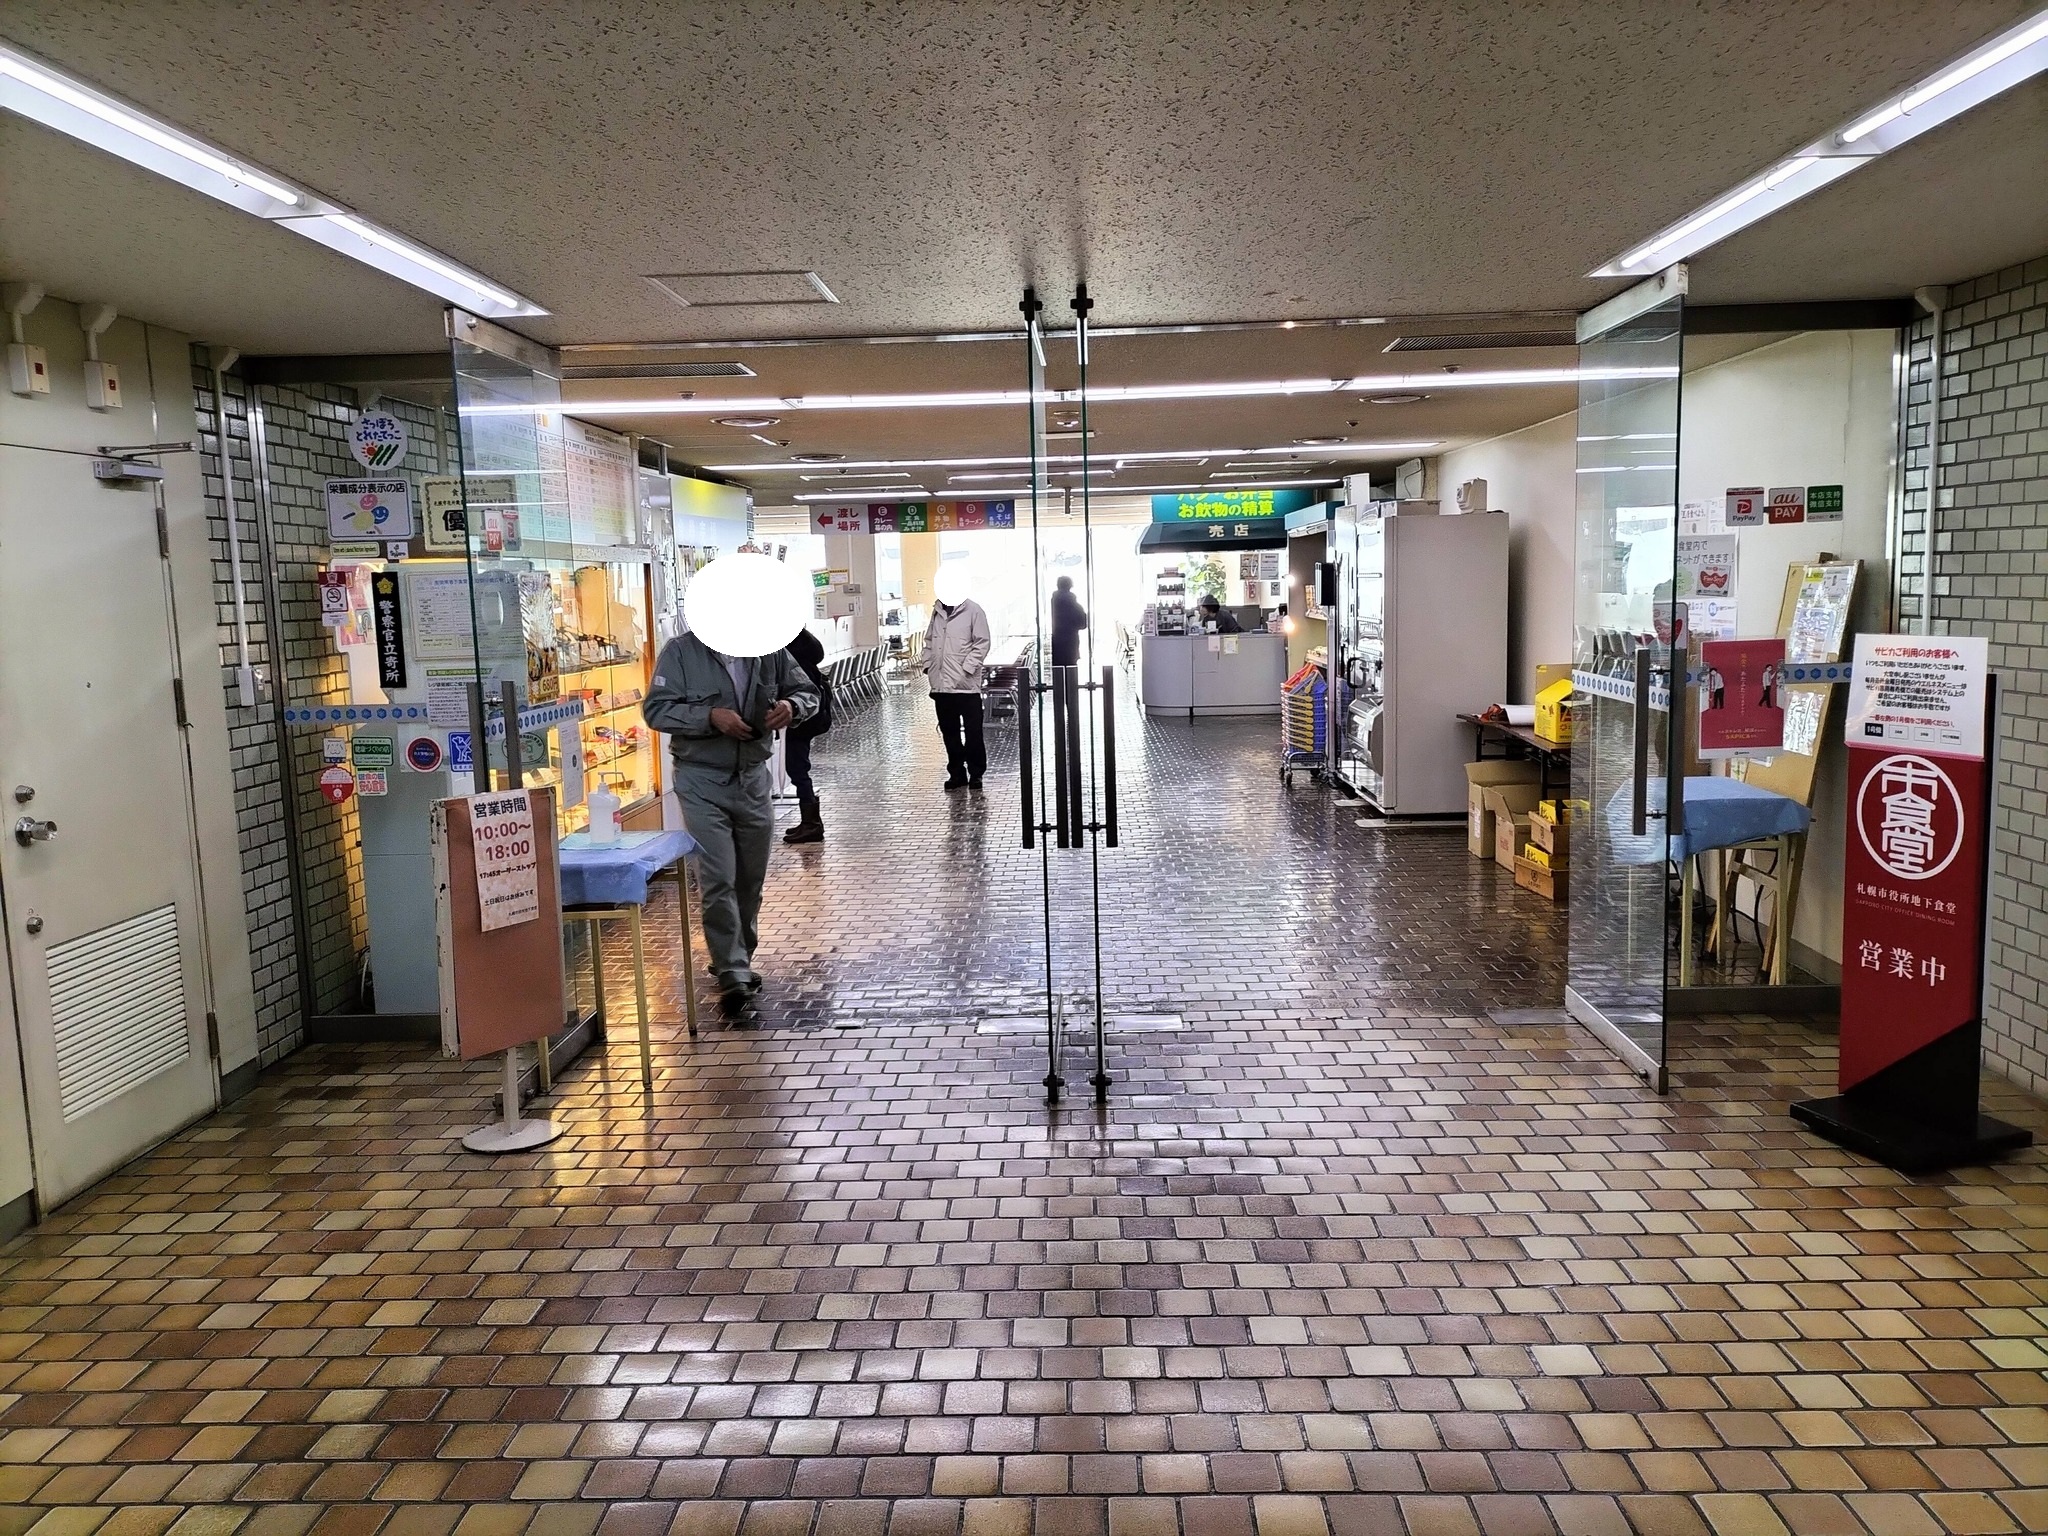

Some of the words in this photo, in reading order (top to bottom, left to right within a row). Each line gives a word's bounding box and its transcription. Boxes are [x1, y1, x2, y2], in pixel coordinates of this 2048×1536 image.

[361, 418, 395, 430] さっぽろ
[356, 430, 402, 442] とれたてっこ
[329, 483, 406, 494] 栄養成分表示の店
[1774, 493, 1799, 504] au
[1809, 491, 1841, 499] 本店支持
[1178, 501, 1275, 518] お飲物の精算
[1809, 499, 1841, 508] 微信支付
[837, 508, 859, 519] 渡し
[1775, 507, 1798, 518] PAY
[837, 521, 860, 531] 場所
[964, 517, 985, 526] ラーメン
[994, 520, 1013, 528] うどん
[1208, 524, 1250, 537] 売店
[1679, 540, 1708, 551] 食堂内で
[379, 600, 400, 683] 警察官立寄所
[1875, 647, 1959, 659] サピカご利用のお客様へ
[474, 796, 527, 819] 営業時間
[486, 840, 530, 861] 18:00
[1856, 883, 1957, 915] 札幌市役所地下食堂
[1881, 903, 1893, 912] CITY
[1895, 906, 1914, 917] OFFICE
[1915, 912, 1936, 922] DINING
[1937, 916, 1955, 926] ROOM
[1859, 939, 1947, 988] 営業中
